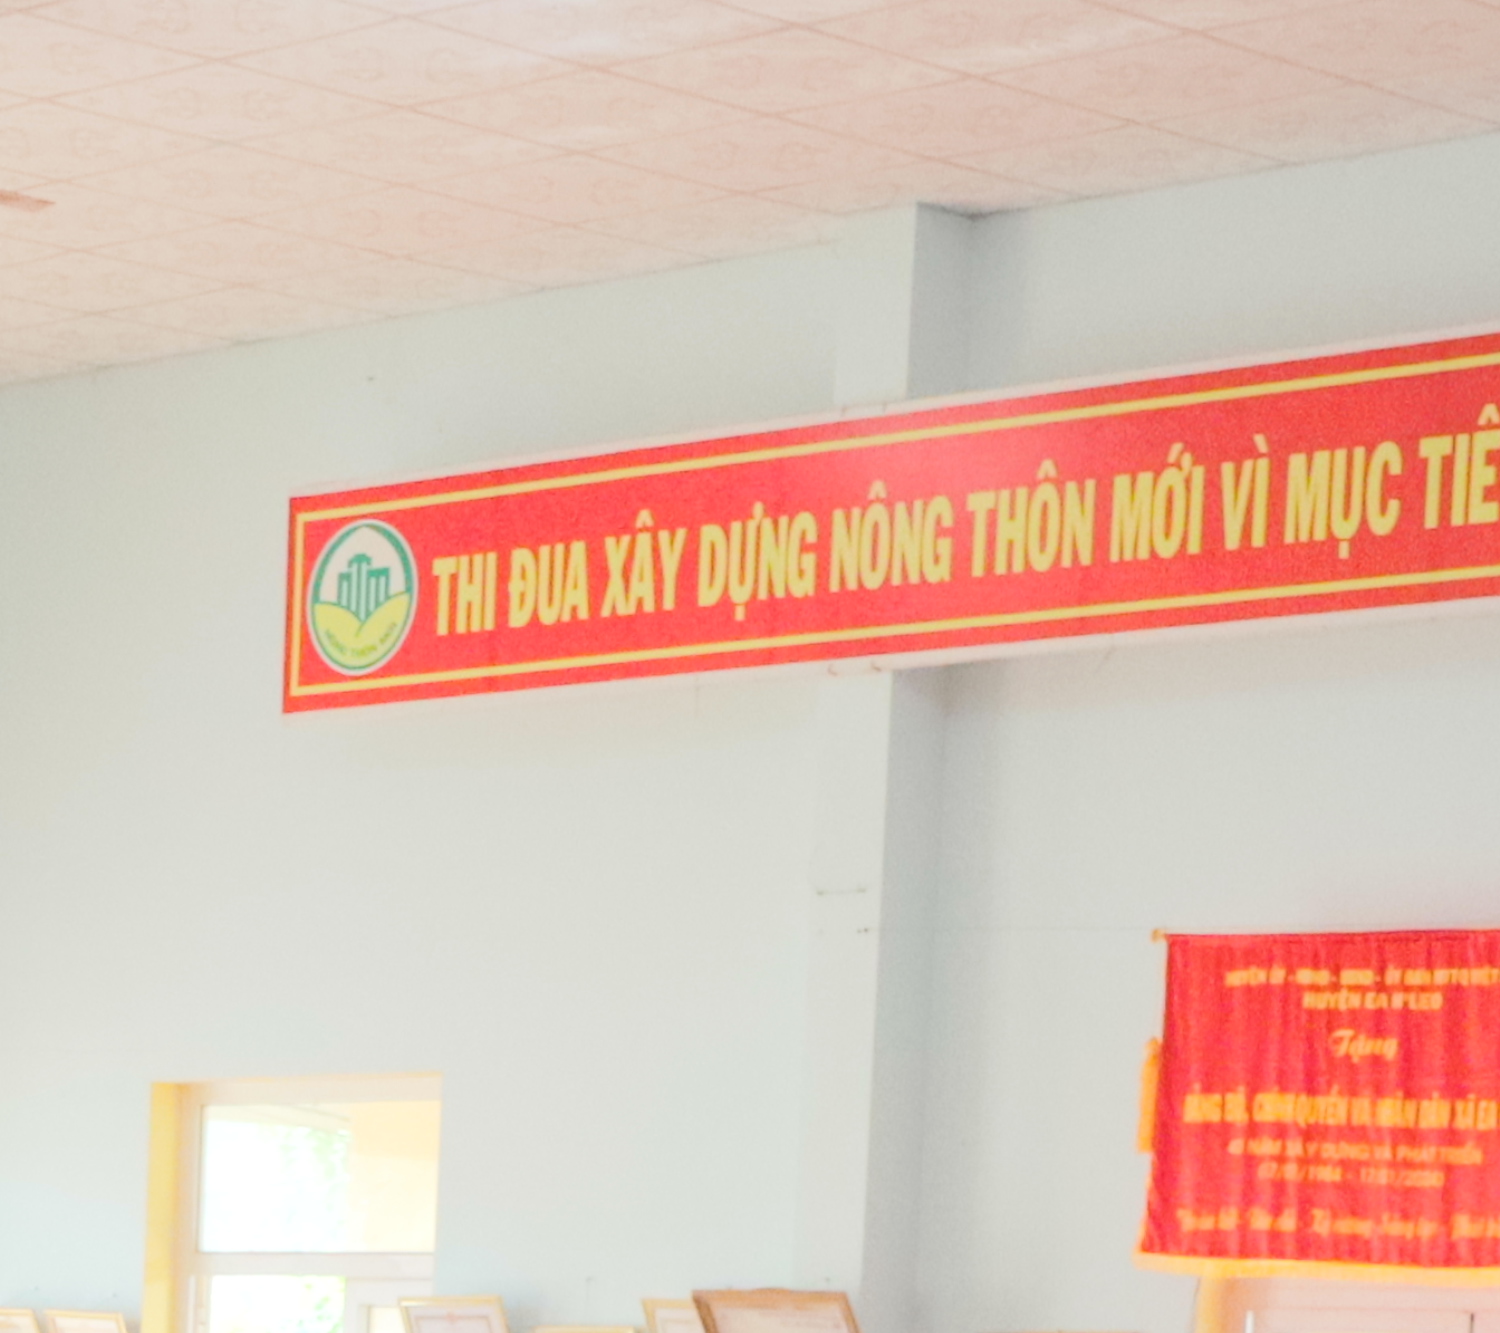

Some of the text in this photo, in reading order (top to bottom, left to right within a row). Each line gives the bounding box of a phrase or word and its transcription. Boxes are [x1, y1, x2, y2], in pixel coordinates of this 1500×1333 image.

[432, 541, 498, 636] THI
[507, 540, 590, 628] ĐUA
[600, 509, 688, 617] XÂY
[697, 502, 819, 621] DỰNG
[829, 481, 956, 592] NÔNG
[965, 458, 1097, 578] THÔN
[1109, 442, 1206, 562] MỚI
[1221, 434, 1271, 551] VÌ
[1284, 428, 1403, 560] MỤC
